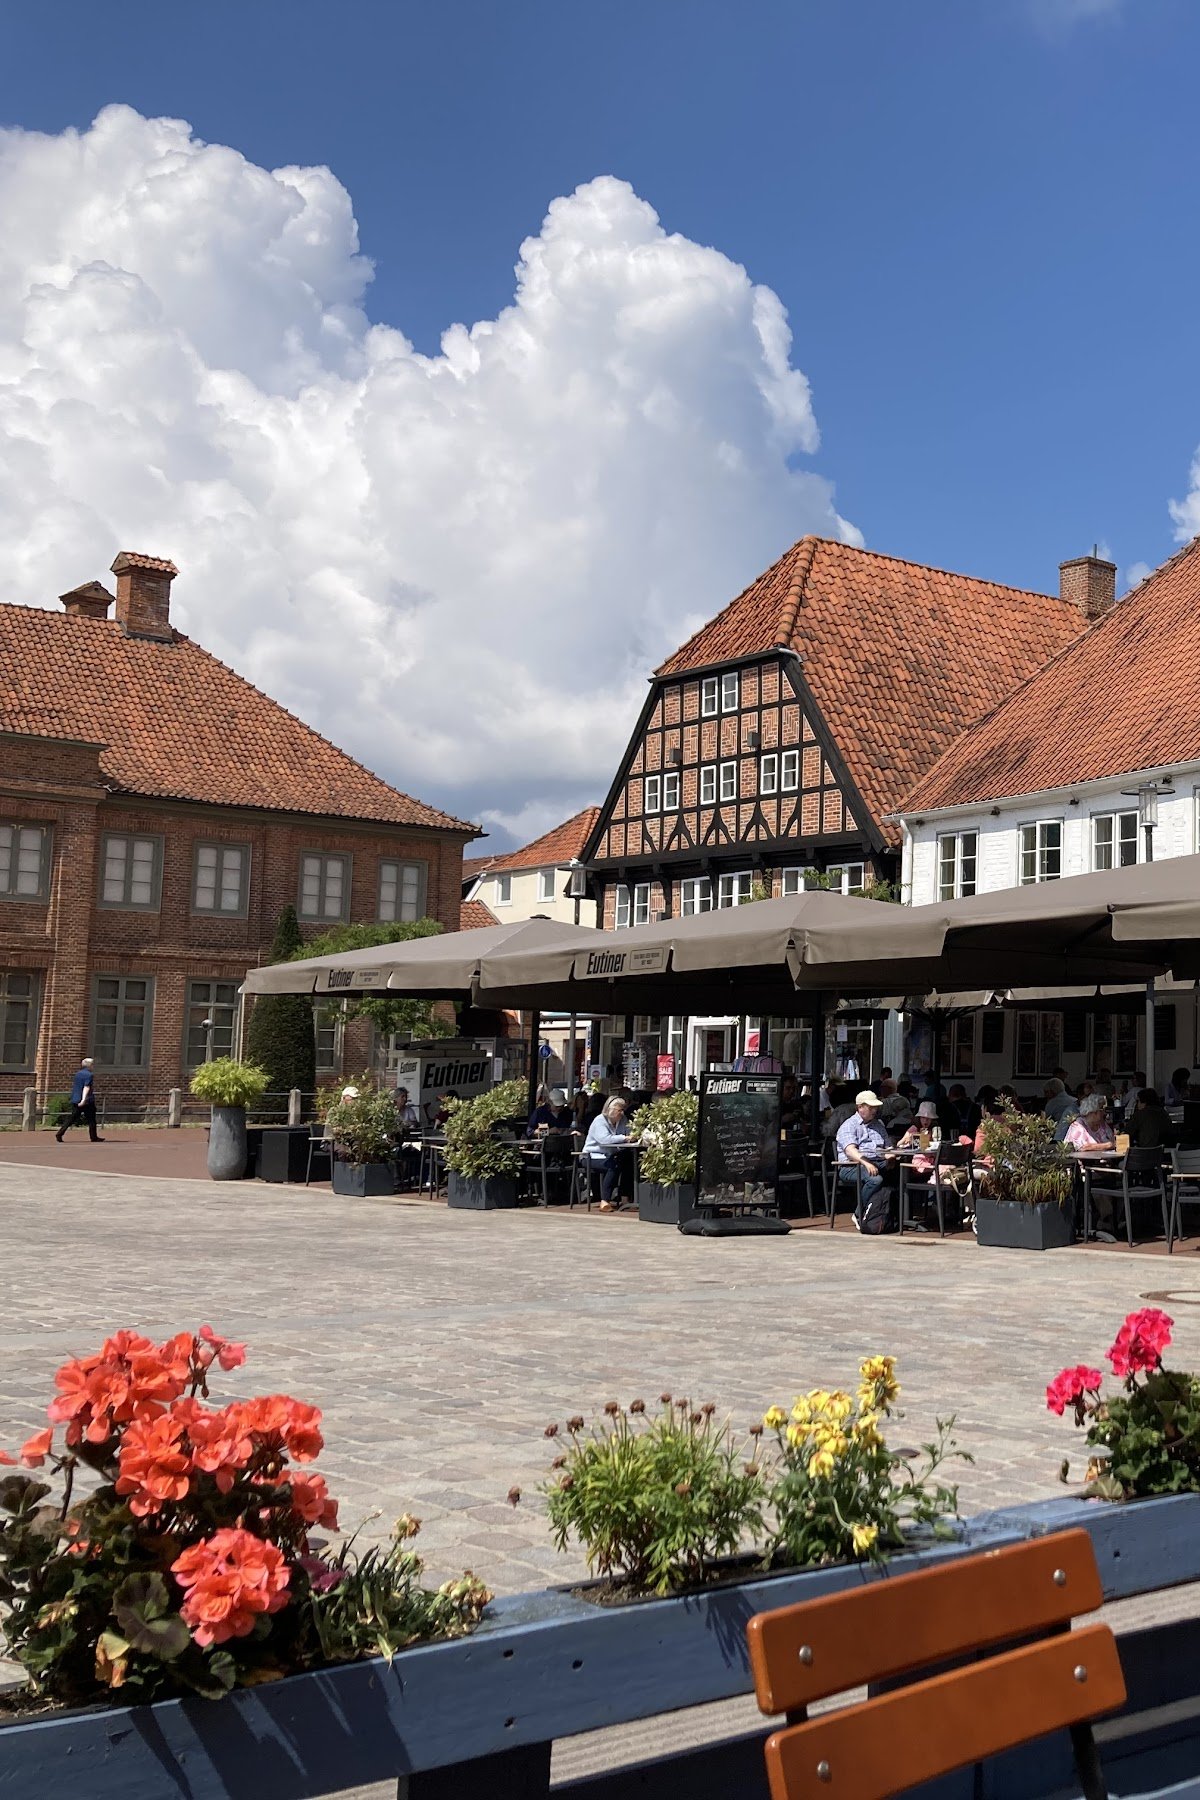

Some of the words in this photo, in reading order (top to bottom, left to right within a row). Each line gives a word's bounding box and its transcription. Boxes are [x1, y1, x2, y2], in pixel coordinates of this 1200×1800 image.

[586, 950, 627, 975] Eutiner
[328, 967, 355, 988] Eutiner
[422, 1060, 489, 1090] Eutiner
[658, 1066, 673, 1075] SALE
[706, 1077, 743, 1095] Eutiner
